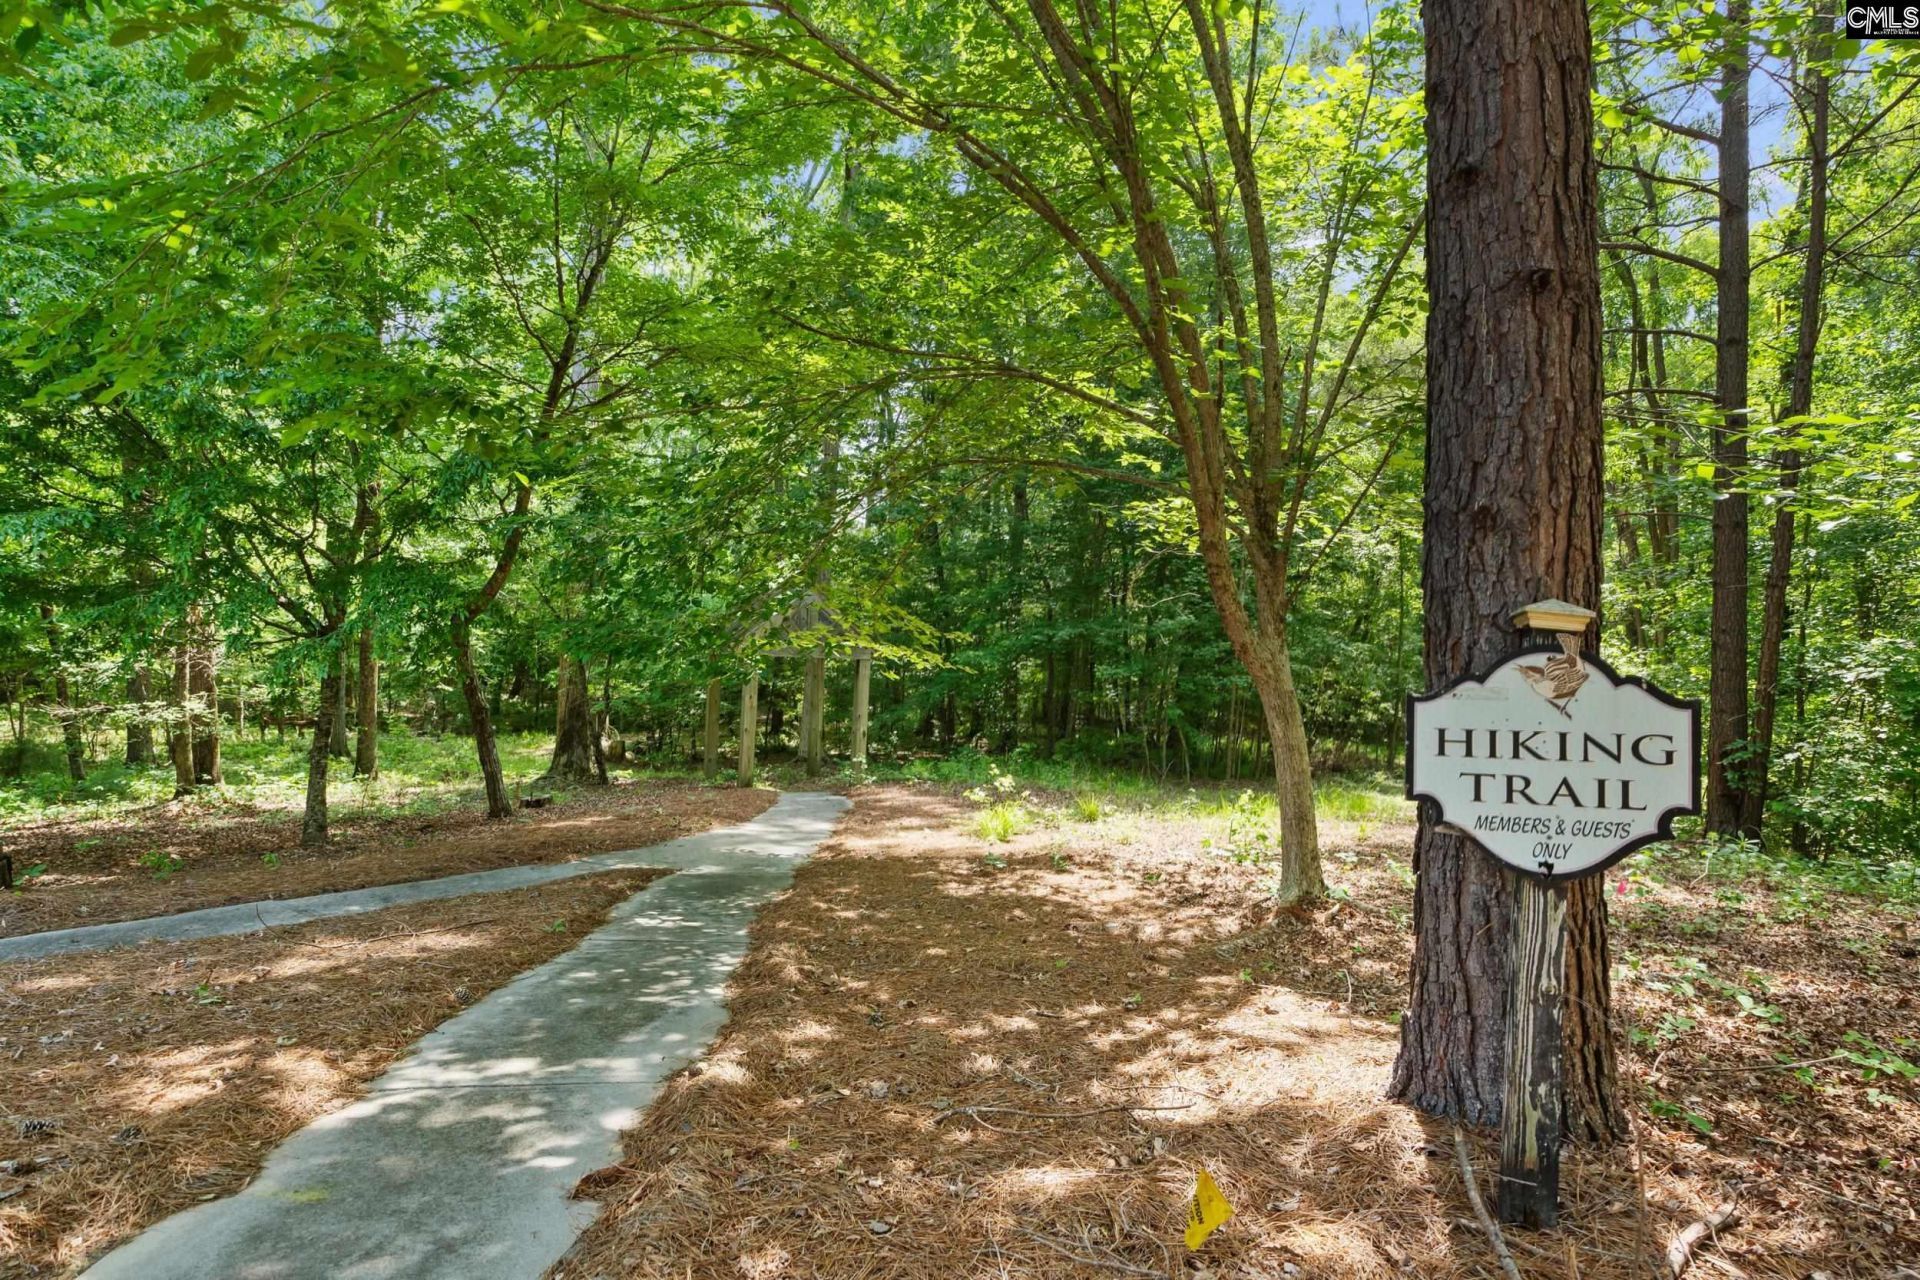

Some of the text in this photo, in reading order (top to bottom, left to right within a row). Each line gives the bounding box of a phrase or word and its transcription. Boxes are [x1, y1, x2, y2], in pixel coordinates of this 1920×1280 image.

[1434, 727, 1677, 766] HIKING
[1459, 772, 1647, 811] TRAIL
[1474, 815, 1632, 839] MEMBERS & GUESTS
[1532, 841, 1573, 860] ONLY
